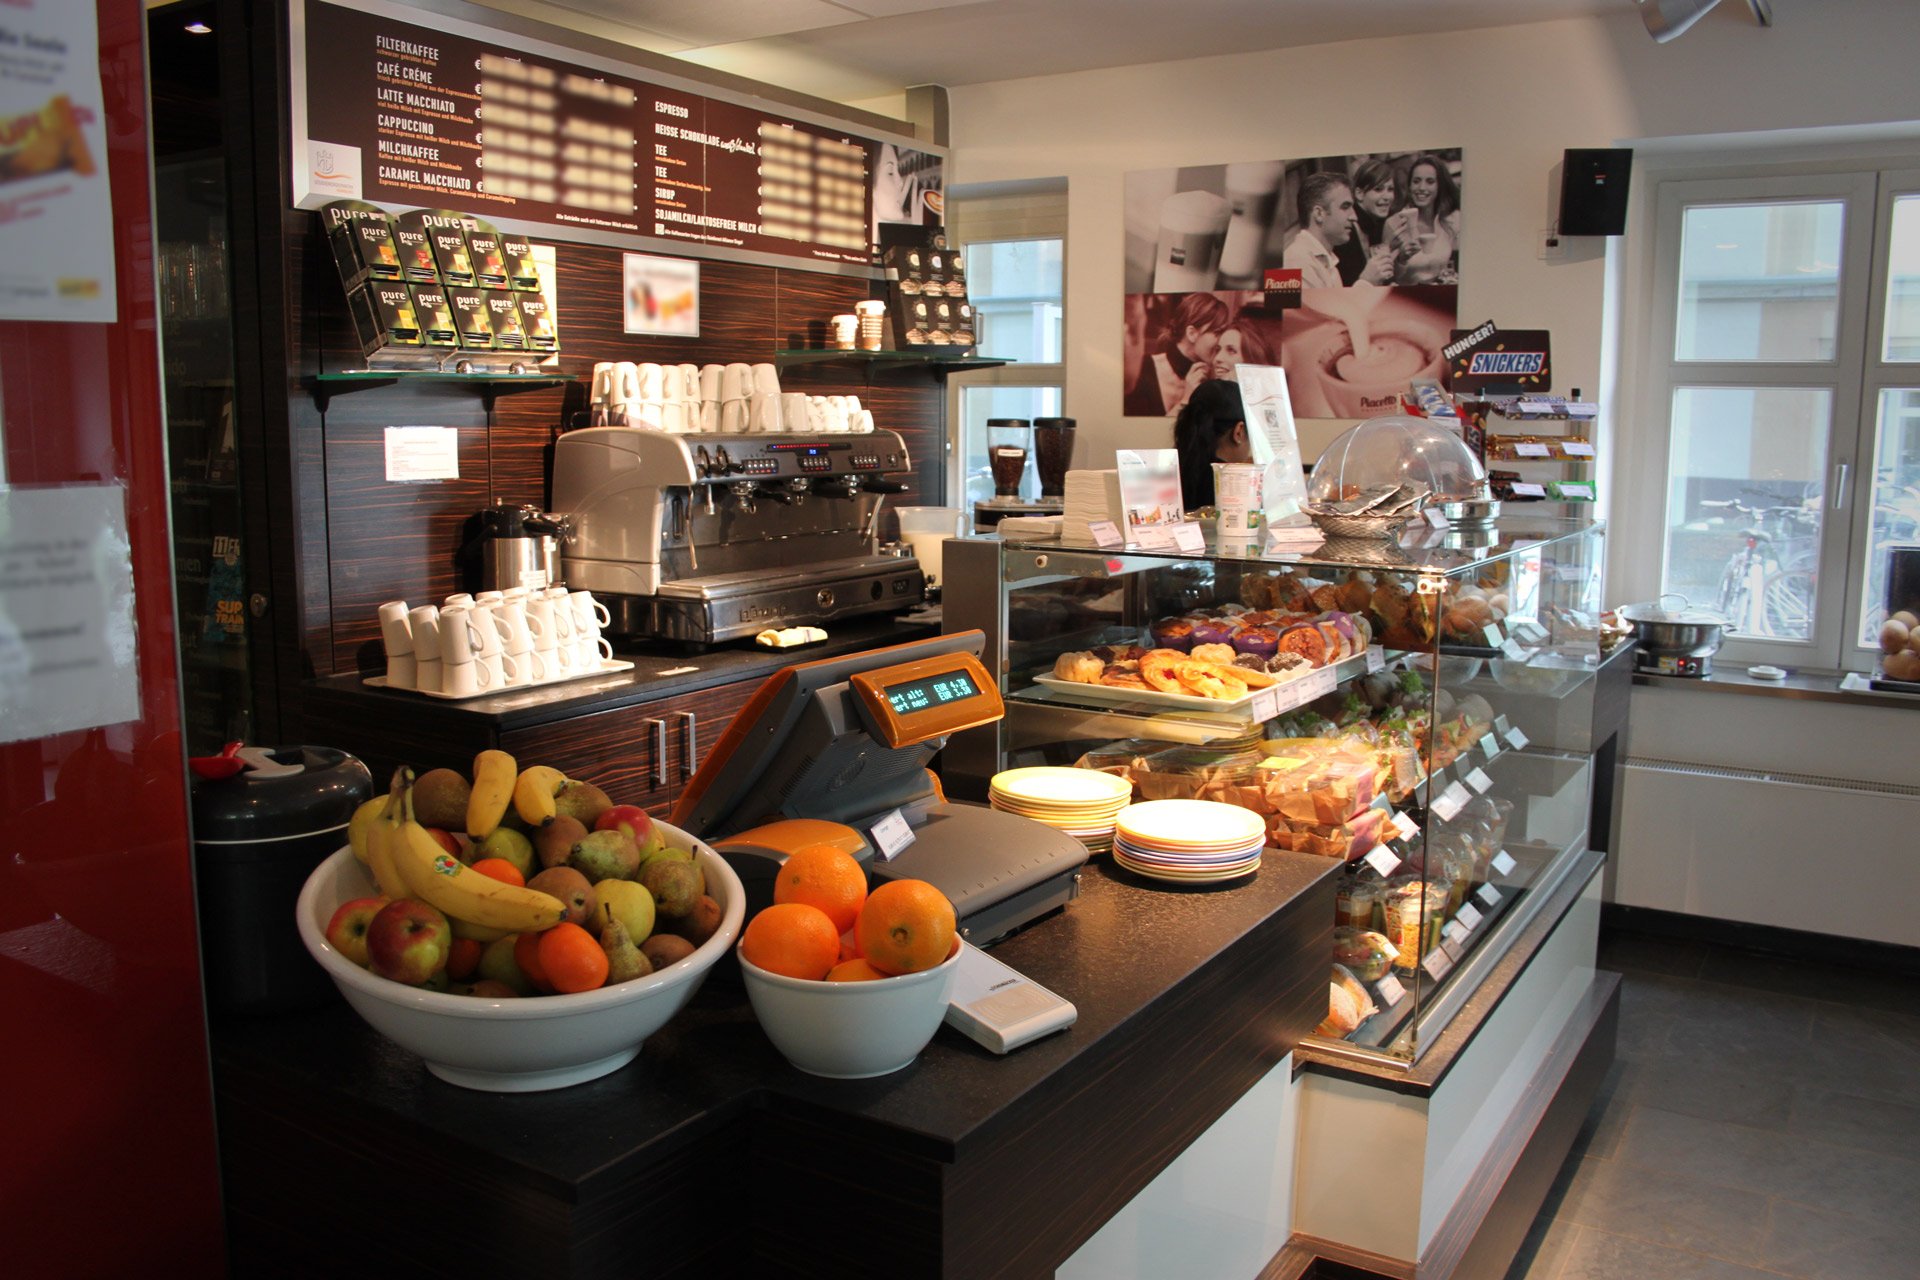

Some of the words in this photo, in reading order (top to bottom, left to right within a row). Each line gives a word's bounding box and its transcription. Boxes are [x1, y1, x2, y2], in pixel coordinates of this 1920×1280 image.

[376, 35, 440, 61] FILTERKAFFEE
[377, 61, 400, 77] CAFÉ
[403, 66, 433, 84] CRÉME
[377, 87, 404, 103] LATTE
[407, 93, 455, 113] MACCHIATO
[655, 101, 689, 119] ESPRESSO
[378, 114, 434, 135] CAPPUCCINO
[655, 123, 679, 138] HEISSE
[680, 128, 720, 147] SCHOKOLADE
[378, 140, 439, 161] MILCHKAFFEE
[655, 144, 668, 156] TEE
[379, 165, 420, 183] CARAMEL
[423, 172, 471, 190] MACCHIATO
[655, 165, 668, 178] TEE
[655, 187, 675, 200] SIRUP
[330, 208, 368, 226] pure
[422, 214, 461, 229] pure
[655, 208, 737, 231] SOJAMILCH/LAKTOSEFREIE
[738, 221, 756, 234] MILCH
[361, 227, 387, 240] pure
[399, 231, 424, 244] pure
[437, 236, 461, 248] pure
[472, 239, 495, 251] pure
[505, 242, 528, 254] pure
[1264, 278, 1301, 289] Piacetto
[381, 290, 406, 304] pure
[418, 293, 443, 306] pure
[457, 296, 480, 309] pure
[490, 299, 513, 312] pure
[522, 301, 545, 314] pure
[1443, 323, 1496, 360] HUNGER?
[1472, 353, 1543, 373] SNICKERS
[889, 693, 905, 704] ert
[933, 682, 949, 693] EUR
[894, 701, 910, 712] ert
[938, 690, 954, 701] EUR
